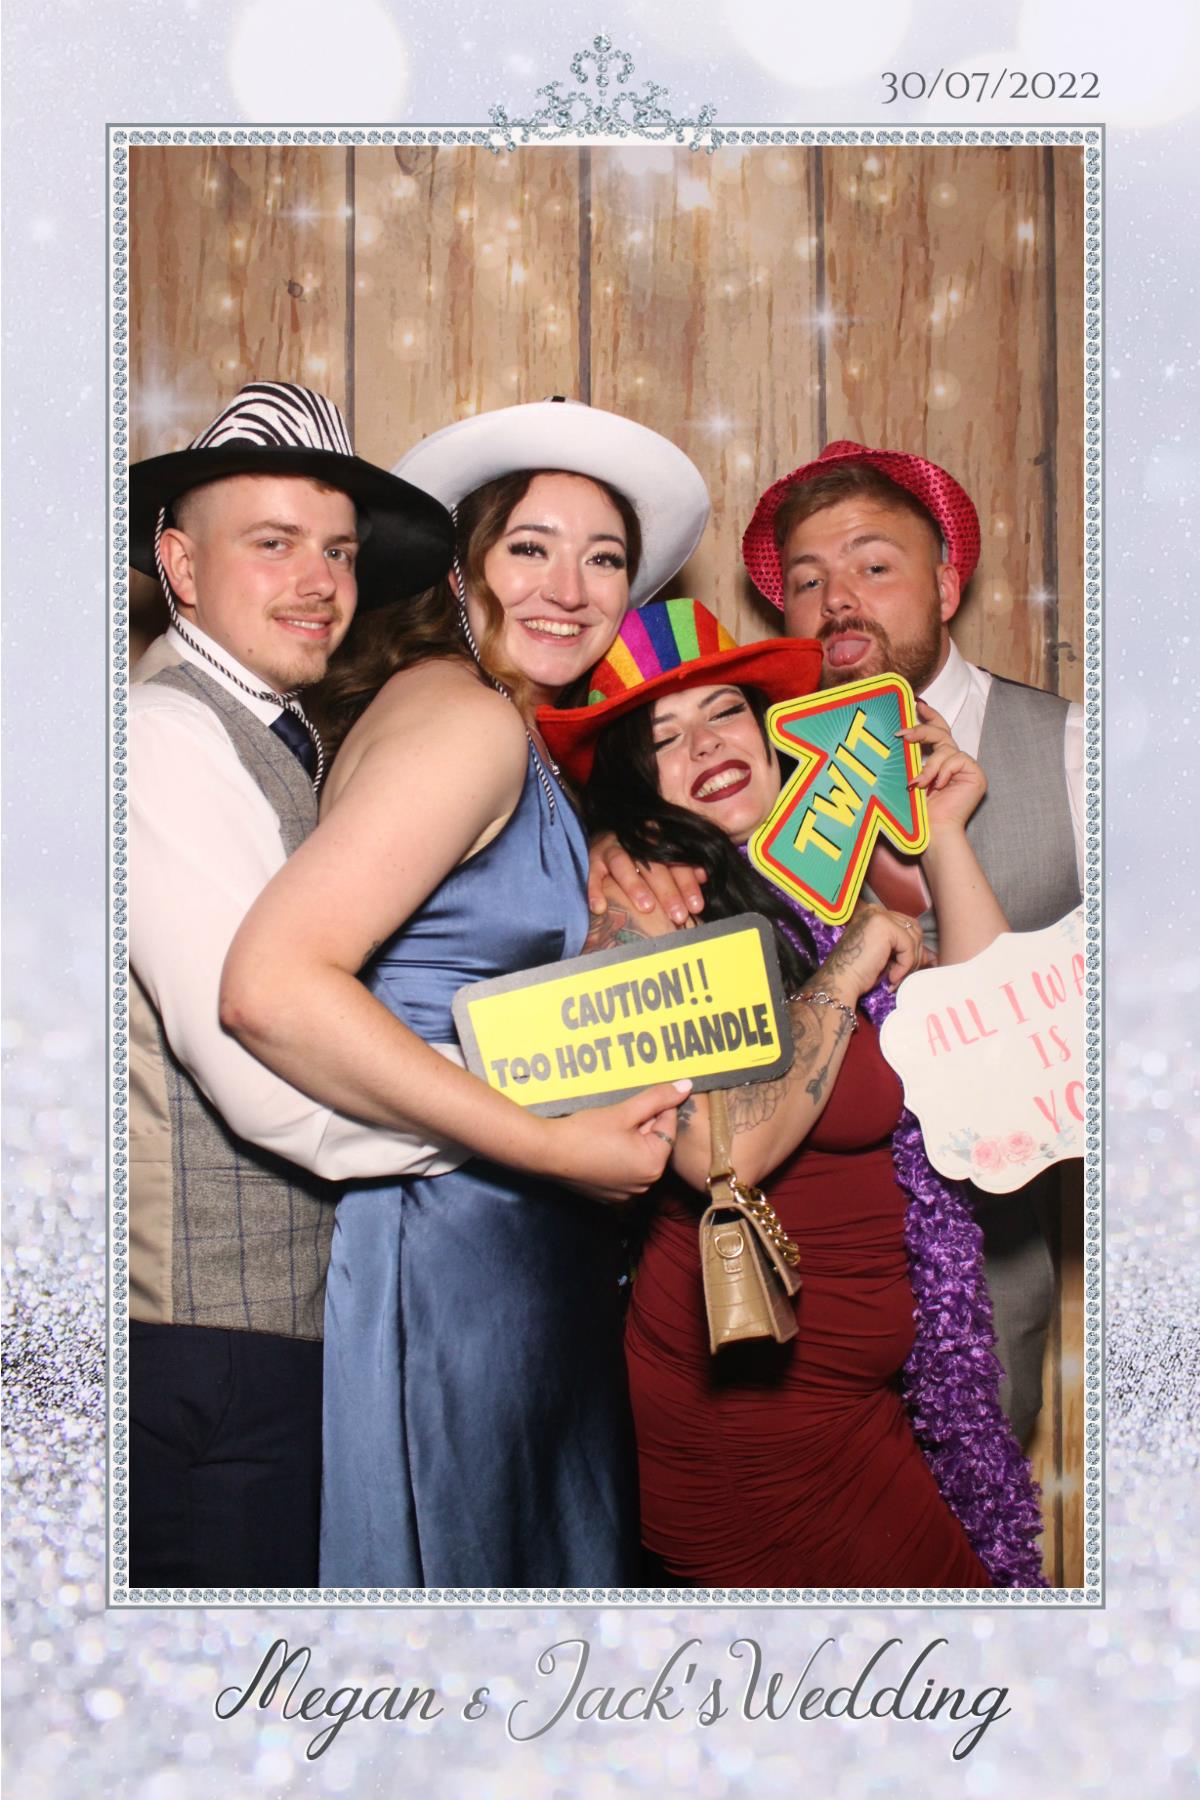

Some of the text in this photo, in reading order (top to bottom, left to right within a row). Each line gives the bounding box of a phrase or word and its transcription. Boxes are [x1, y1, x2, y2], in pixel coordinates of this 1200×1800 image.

[793, 707, 891, 861] TWIT
[561, 958, 713, 1031] CAUTION!!
[926, 999, 999, 1056] ALL
[999, 980, 1029, 1025] I
[490, 1003, 773, 1088] TOO HOT TO HANDLE
[1028, 1025, 1072, 1070] IS
